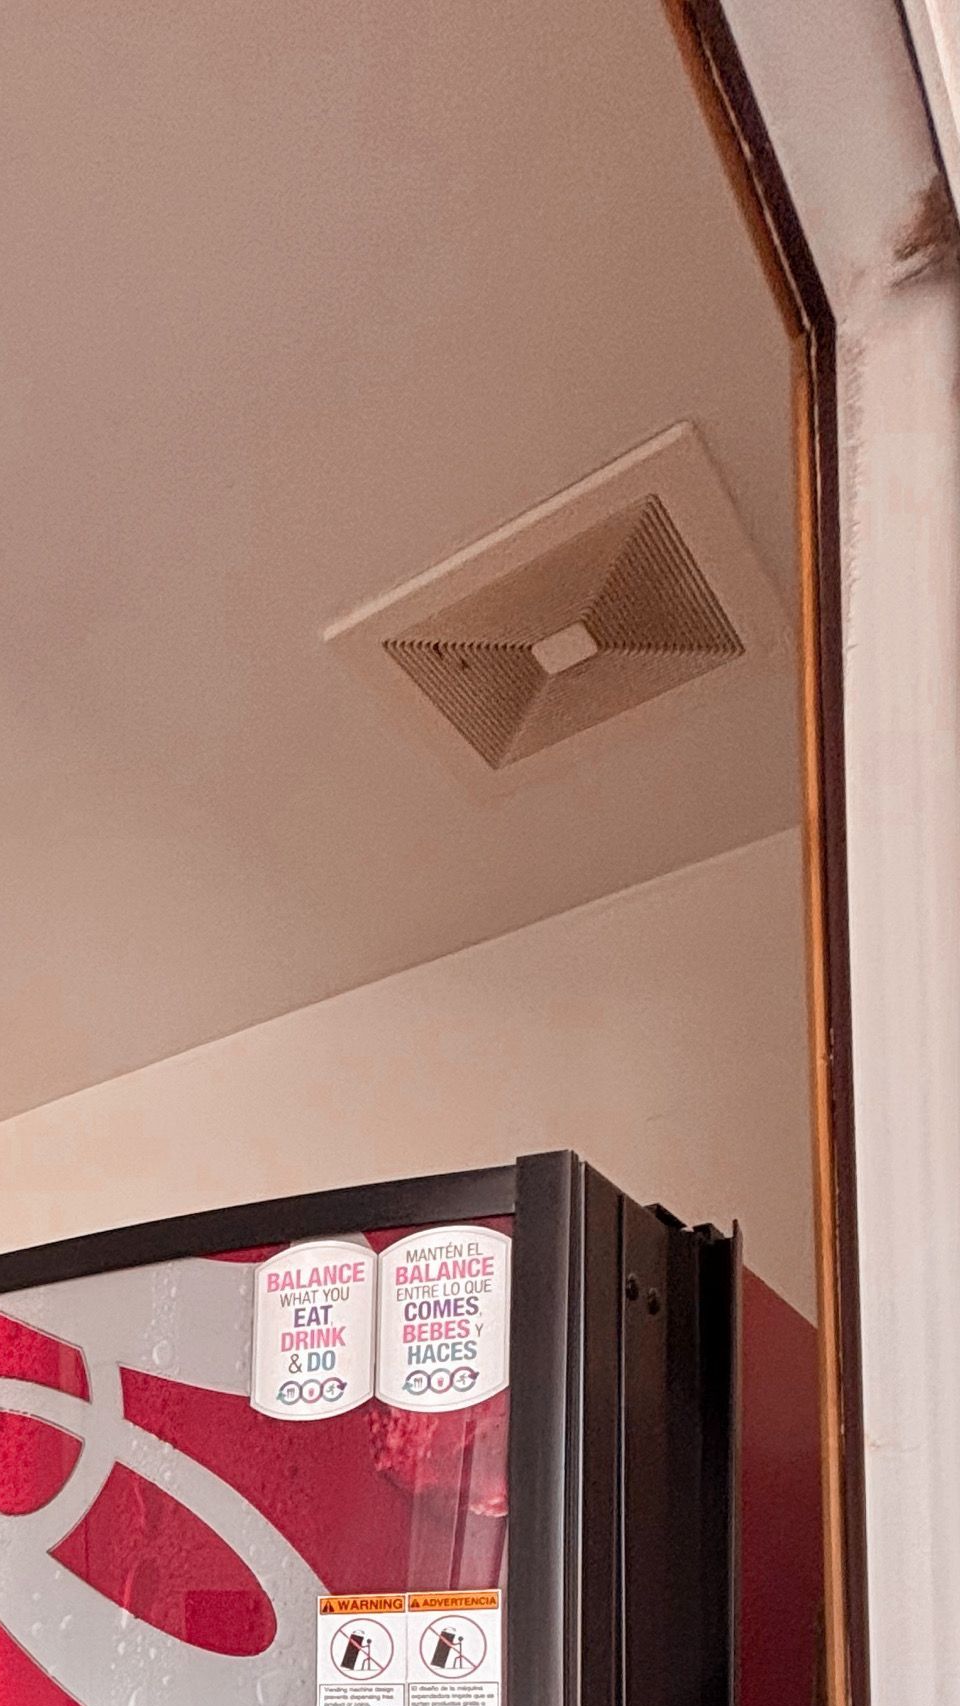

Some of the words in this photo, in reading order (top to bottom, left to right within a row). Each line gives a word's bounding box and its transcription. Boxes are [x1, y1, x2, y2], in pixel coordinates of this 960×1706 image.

[406, 1241, 463, 1263] MANTÉN
[467, 1242, 483, 1257] EL
[266, 1262, 365, 1293] BALANCE
[395, 1257, 494, 1286] BALANCE
[280, 1290, 318, 1308] WHAT
[324, 1286, 350, 1303] YOU
[396, 1284, 440, 1301] ENTRE
[443, 1282, 460, 1297] LO
[464, 1279, 492, 1295] QUE
[280, 1326, 346, 1352] DRINK
[403, 1320, 470, 1344] BEBES
[475, 1324, 484, 1338] Y
[288, 1354, 302, 1374] &
[307, 1350, 336, 1372] DO
[408, 1340, 477, 1365] HACES
[338, 1598, 403, 1612] WARNING
[422, 1597, 497, 1607] ADVERTENCIA
